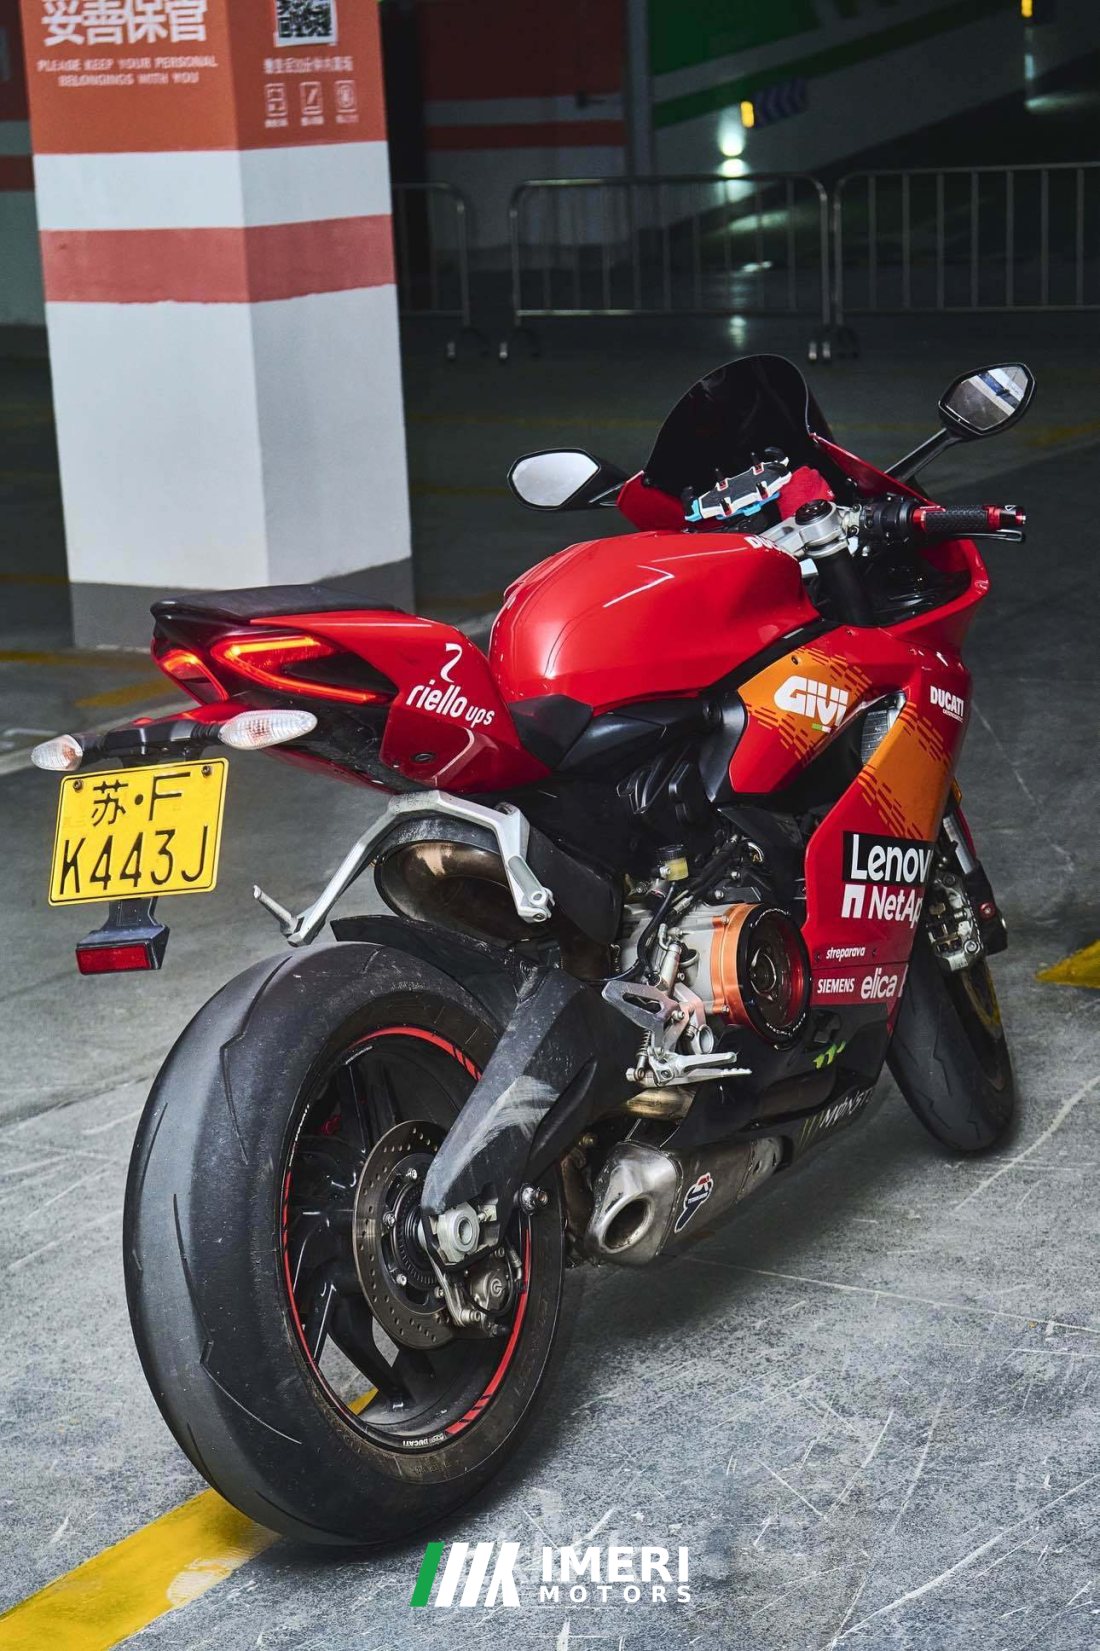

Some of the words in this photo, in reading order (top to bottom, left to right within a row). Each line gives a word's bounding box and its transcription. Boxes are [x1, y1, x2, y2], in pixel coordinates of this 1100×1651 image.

[41, 0, 208, 47] 妥善保管
[405, 678, 468, 718] riello
[465, 705, 495, 728] ups
[774, 675, 849, 726] GIVI
[930, 685, 964, 717] DUCATI
[59, 825, 208, 895] K443J
[851, 834, 934, 883] Lenov
[826, 947, 866, 962] streparava
[817, 978, 855, 993] SIEMENS
[861, 967, 898, 999] elica
